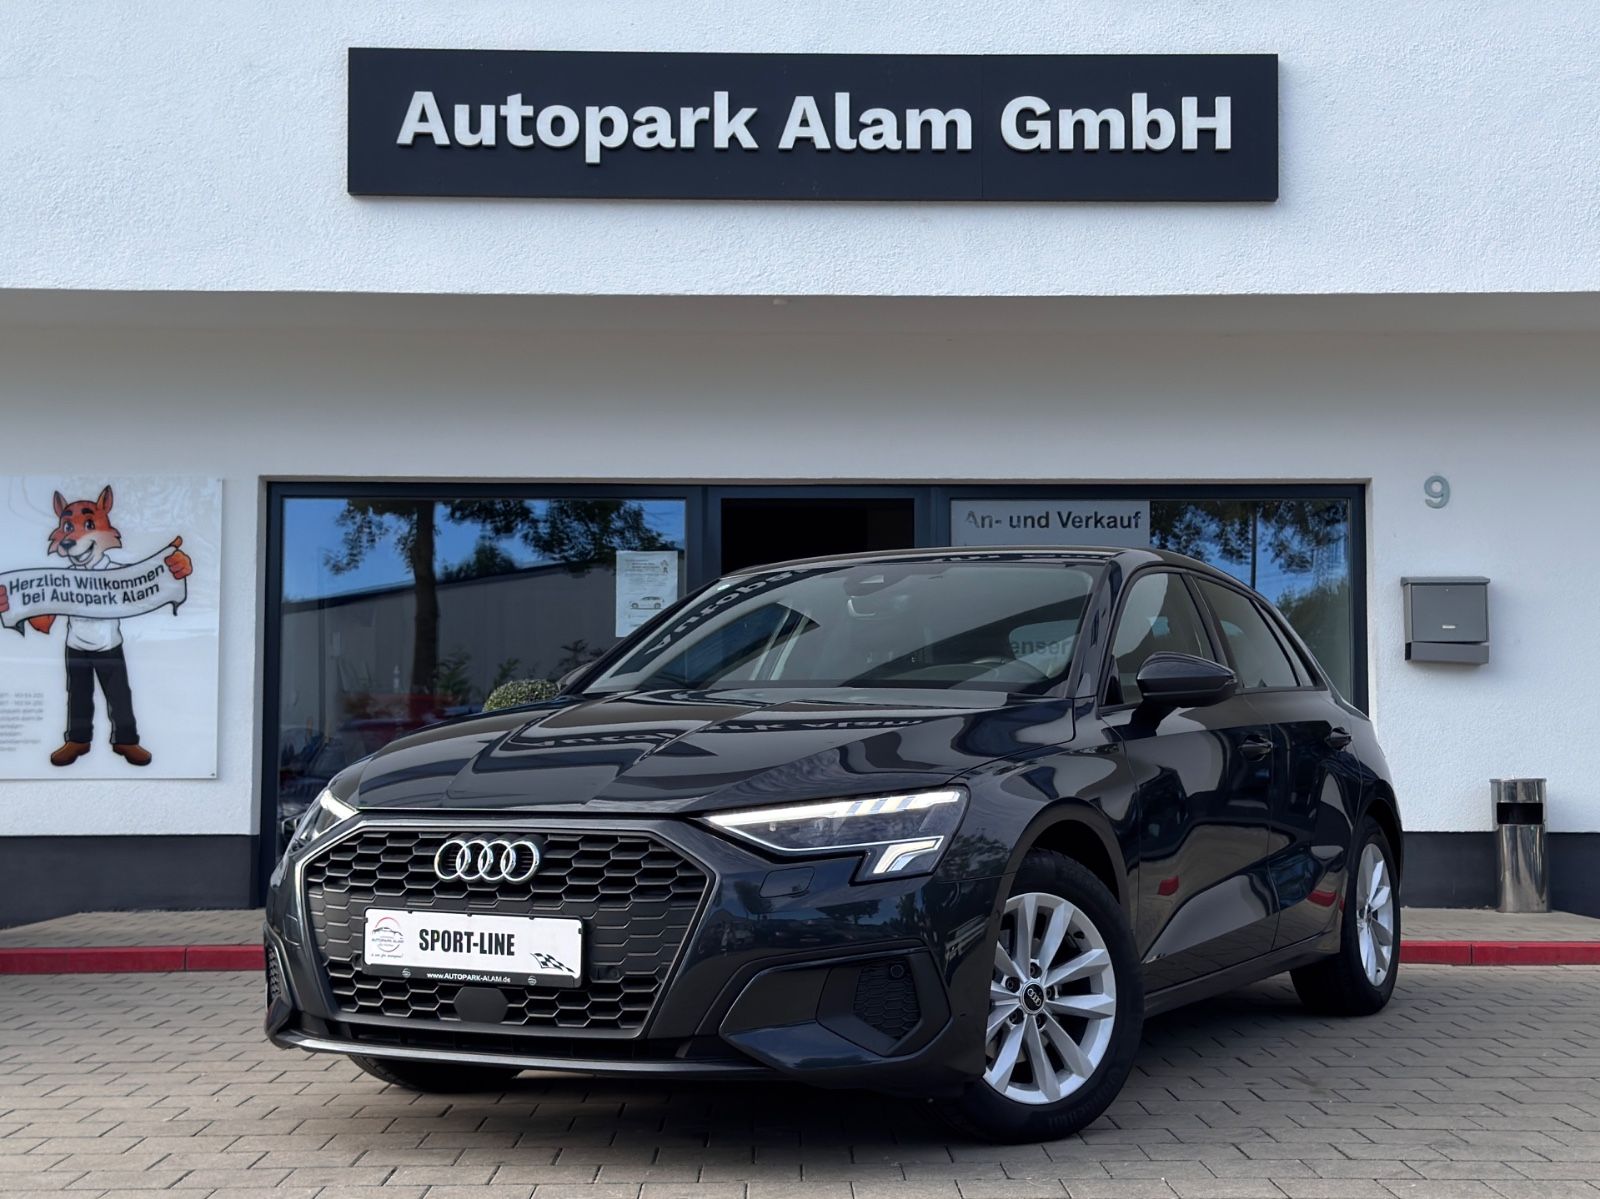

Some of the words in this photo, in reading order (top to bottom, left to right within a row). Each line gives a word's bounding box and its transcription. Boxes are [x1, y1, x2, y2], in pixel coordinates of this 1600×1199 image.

[396, 90, 758, 166] Autopark
[778, 92, 973, 153] Alam
[1000, 92, 1233, 153] GmbH
[1424, 475, 1450, 509] 9
[965, 510, 1002, 529] An-
[1009, 511, 1050, 529] und
[1057, 511, 1142, 529] Verkauf
[9, 574, 71, 596] Herzlich
[74, 564, 165, 591] Willkommen
[22, 590, 46, 606] bei
[51, 588, 117, 606] Autopark
[122, 583, 160, 605] Alam
[418, 929, 515, 956] SPORT-LINE
[426, 972, 511, 983] www.AUTOPARK-ALAM.de
